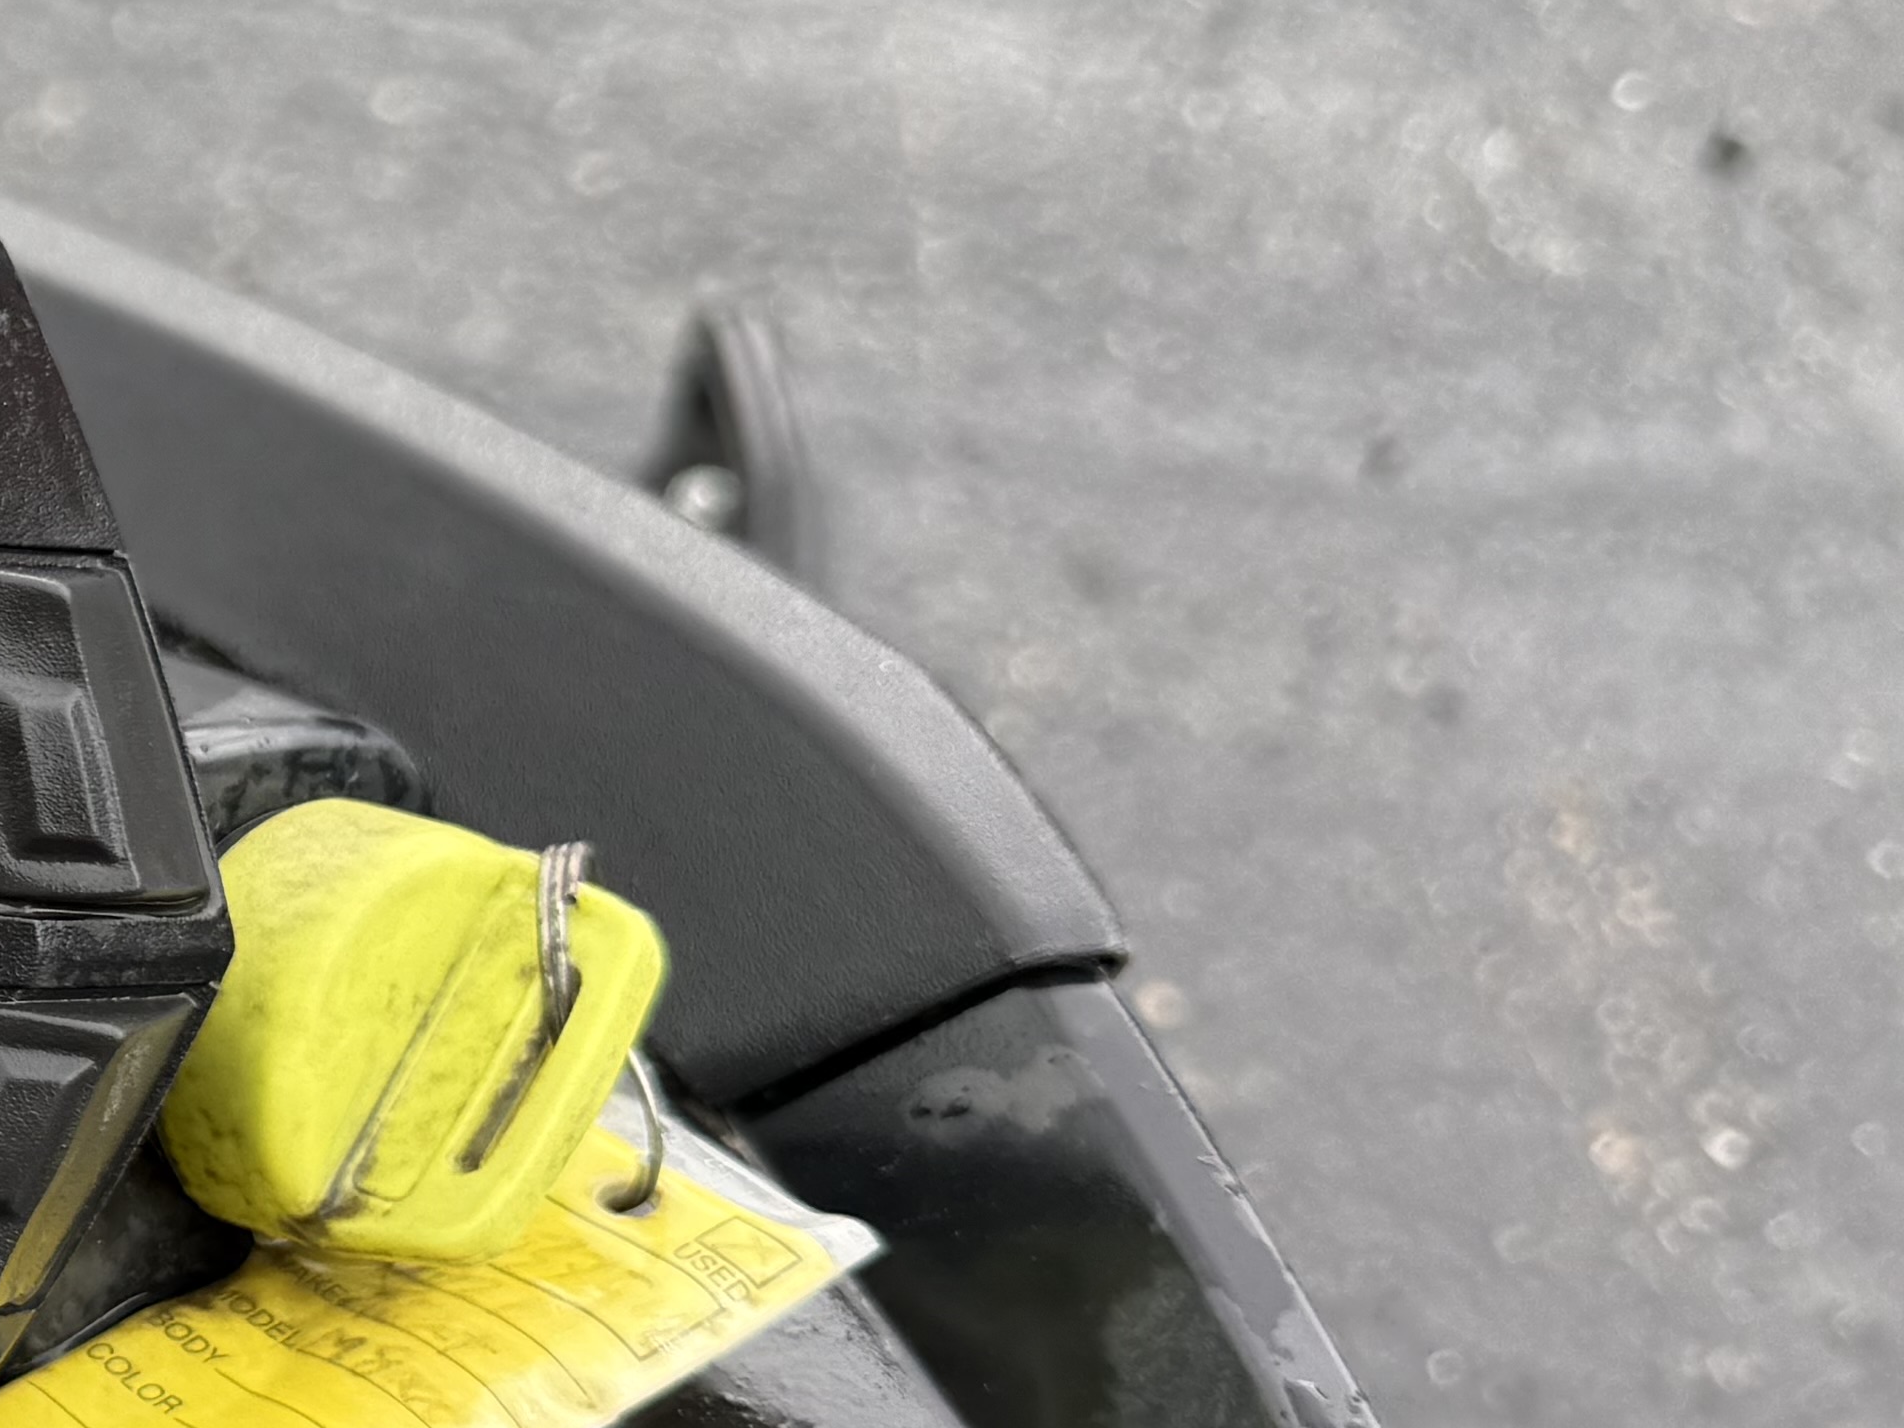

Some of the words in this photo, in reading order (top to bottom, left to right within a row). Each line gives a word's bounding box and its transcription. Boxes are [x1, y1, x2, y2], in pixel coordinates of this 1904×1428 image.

[673, 1241, 751, 1303] USED
[149, 1309, 230, 1363] BODY
[86, 1341, 184, 1415] COLOR
